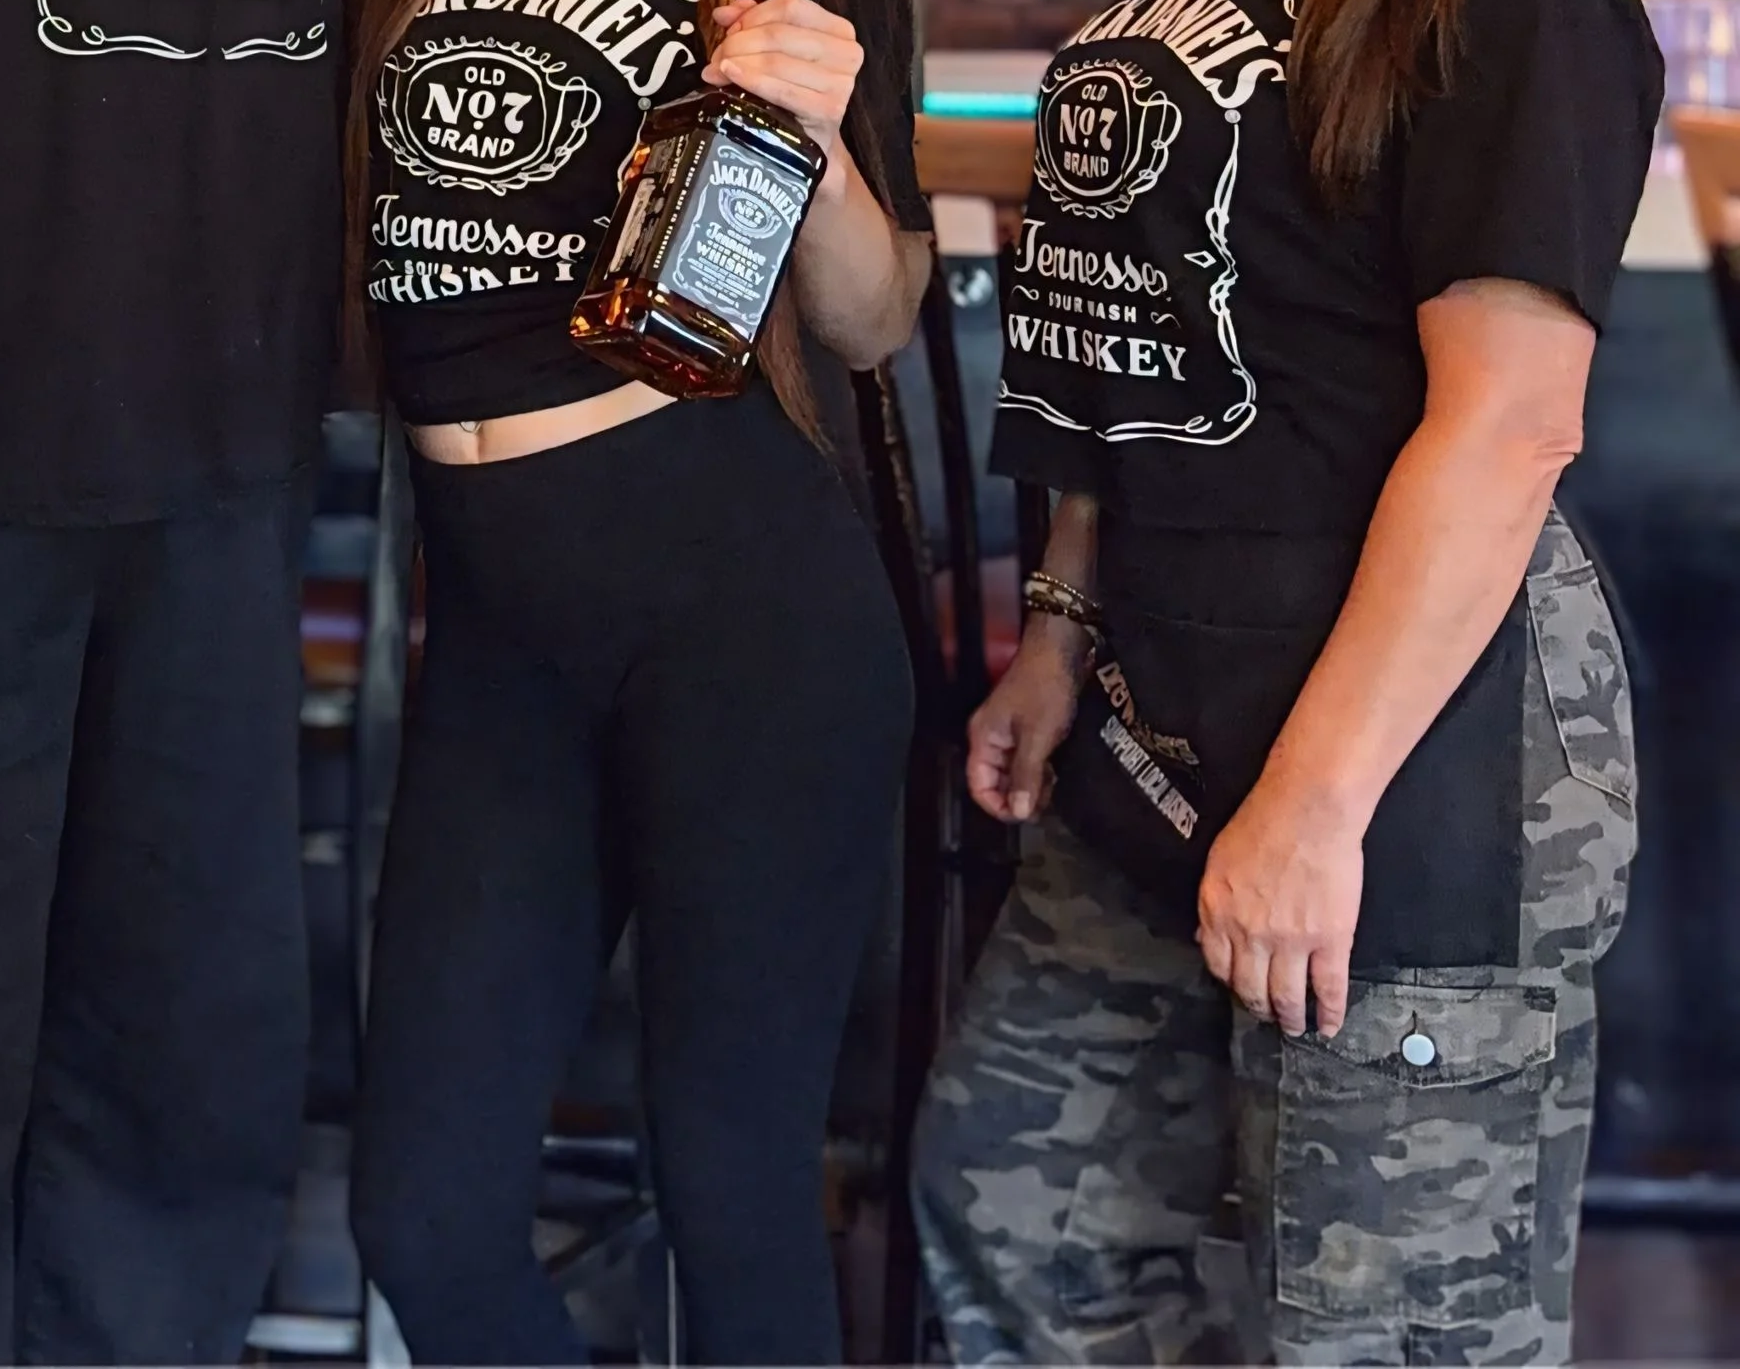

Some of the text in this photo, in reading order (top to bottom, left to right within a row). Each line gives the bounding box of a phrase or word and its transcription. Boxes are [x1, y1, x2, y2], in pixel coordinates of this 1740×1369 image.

[464, 66, 506, 86] OLD
[1080, 83, 1108, 102] OLD
[427, 126, 516, 159] BRAND
[709, 160, 750, 189] JACK
[1063, 151, 1110, 178] BRAND
[371, 194, 587, 267] Tennessee
[1008, 313, 1187, 382] WHISKEY
[1099, 713, 1151, 776] SUPPORT
[1136, 760, 1172, 806] LOCAL
